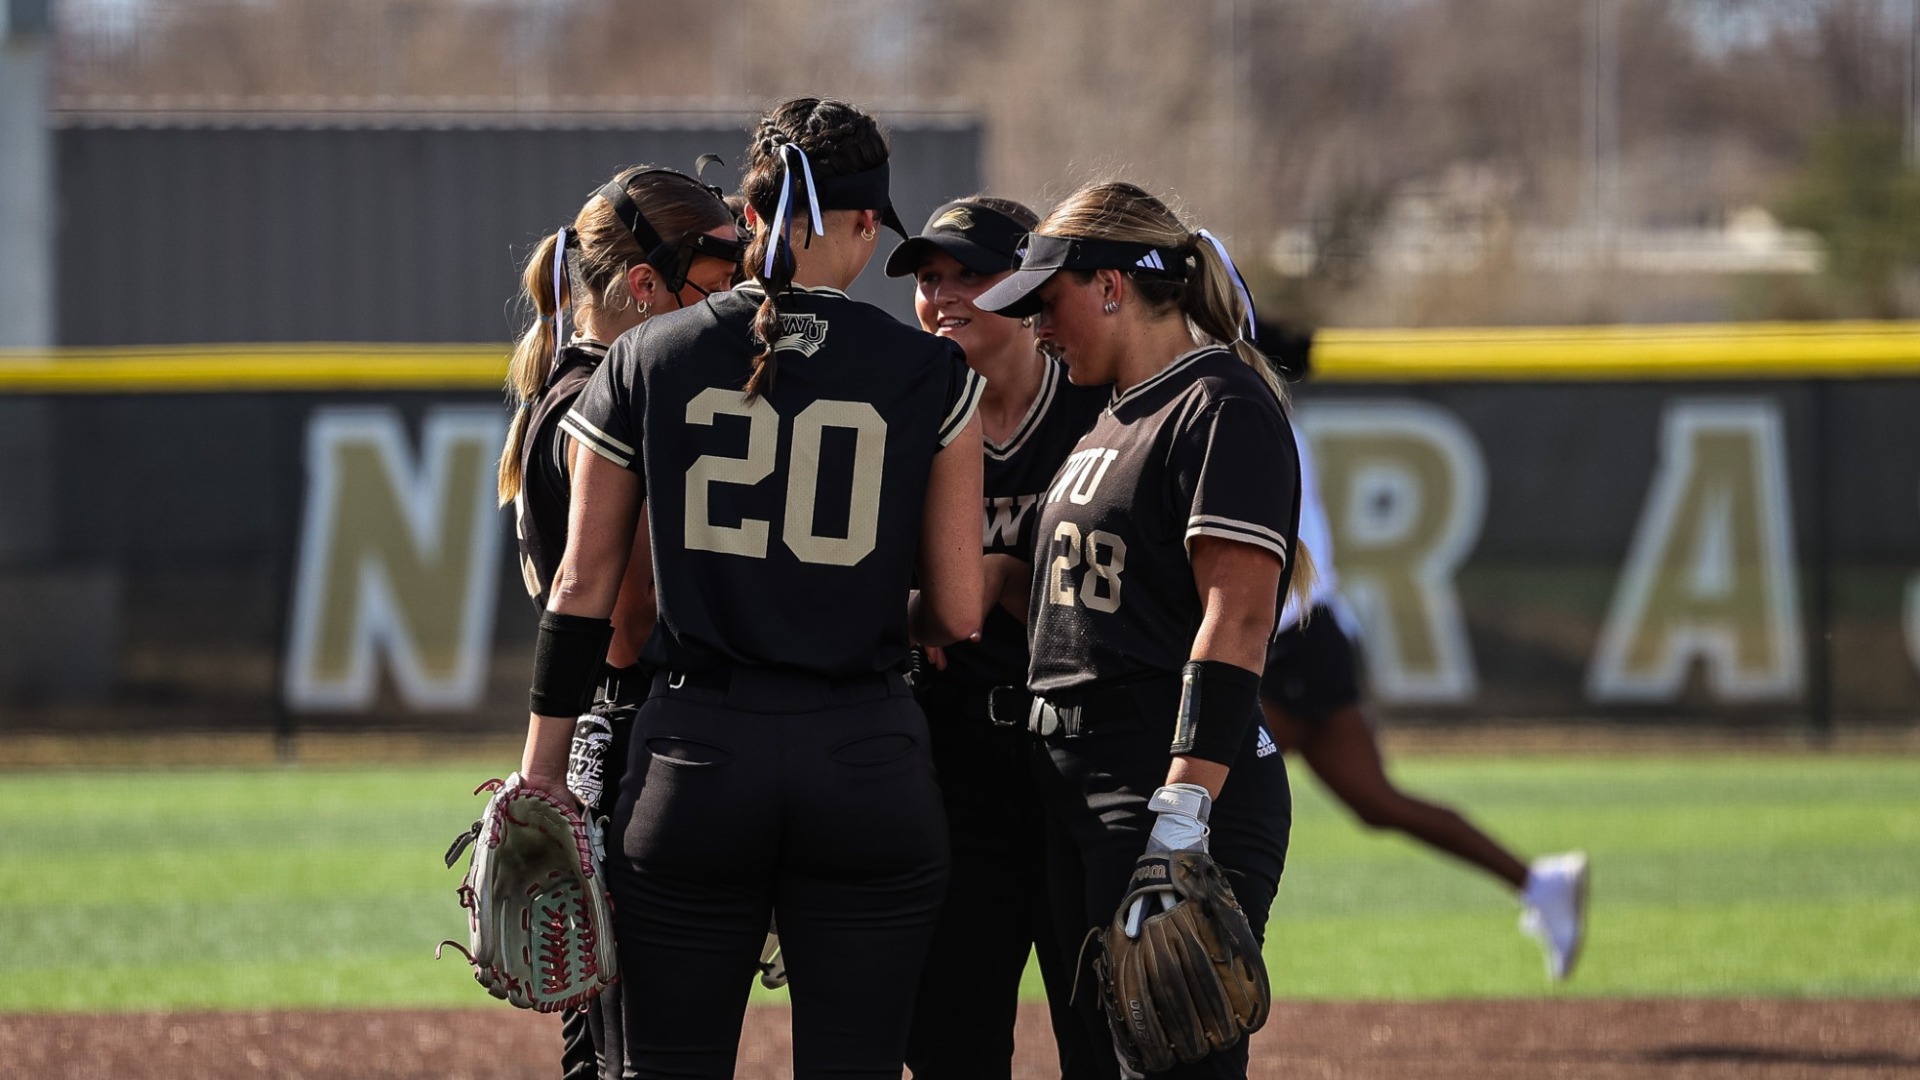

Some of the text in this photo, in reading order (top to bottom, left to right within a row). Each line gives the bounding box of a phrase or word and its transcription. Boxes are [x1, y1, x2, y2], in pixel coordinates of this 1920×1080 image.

[757, 313, 828, 345] WU
[684, 387, 888, 566] 20
[1050, 521, 1127, 614] 28
